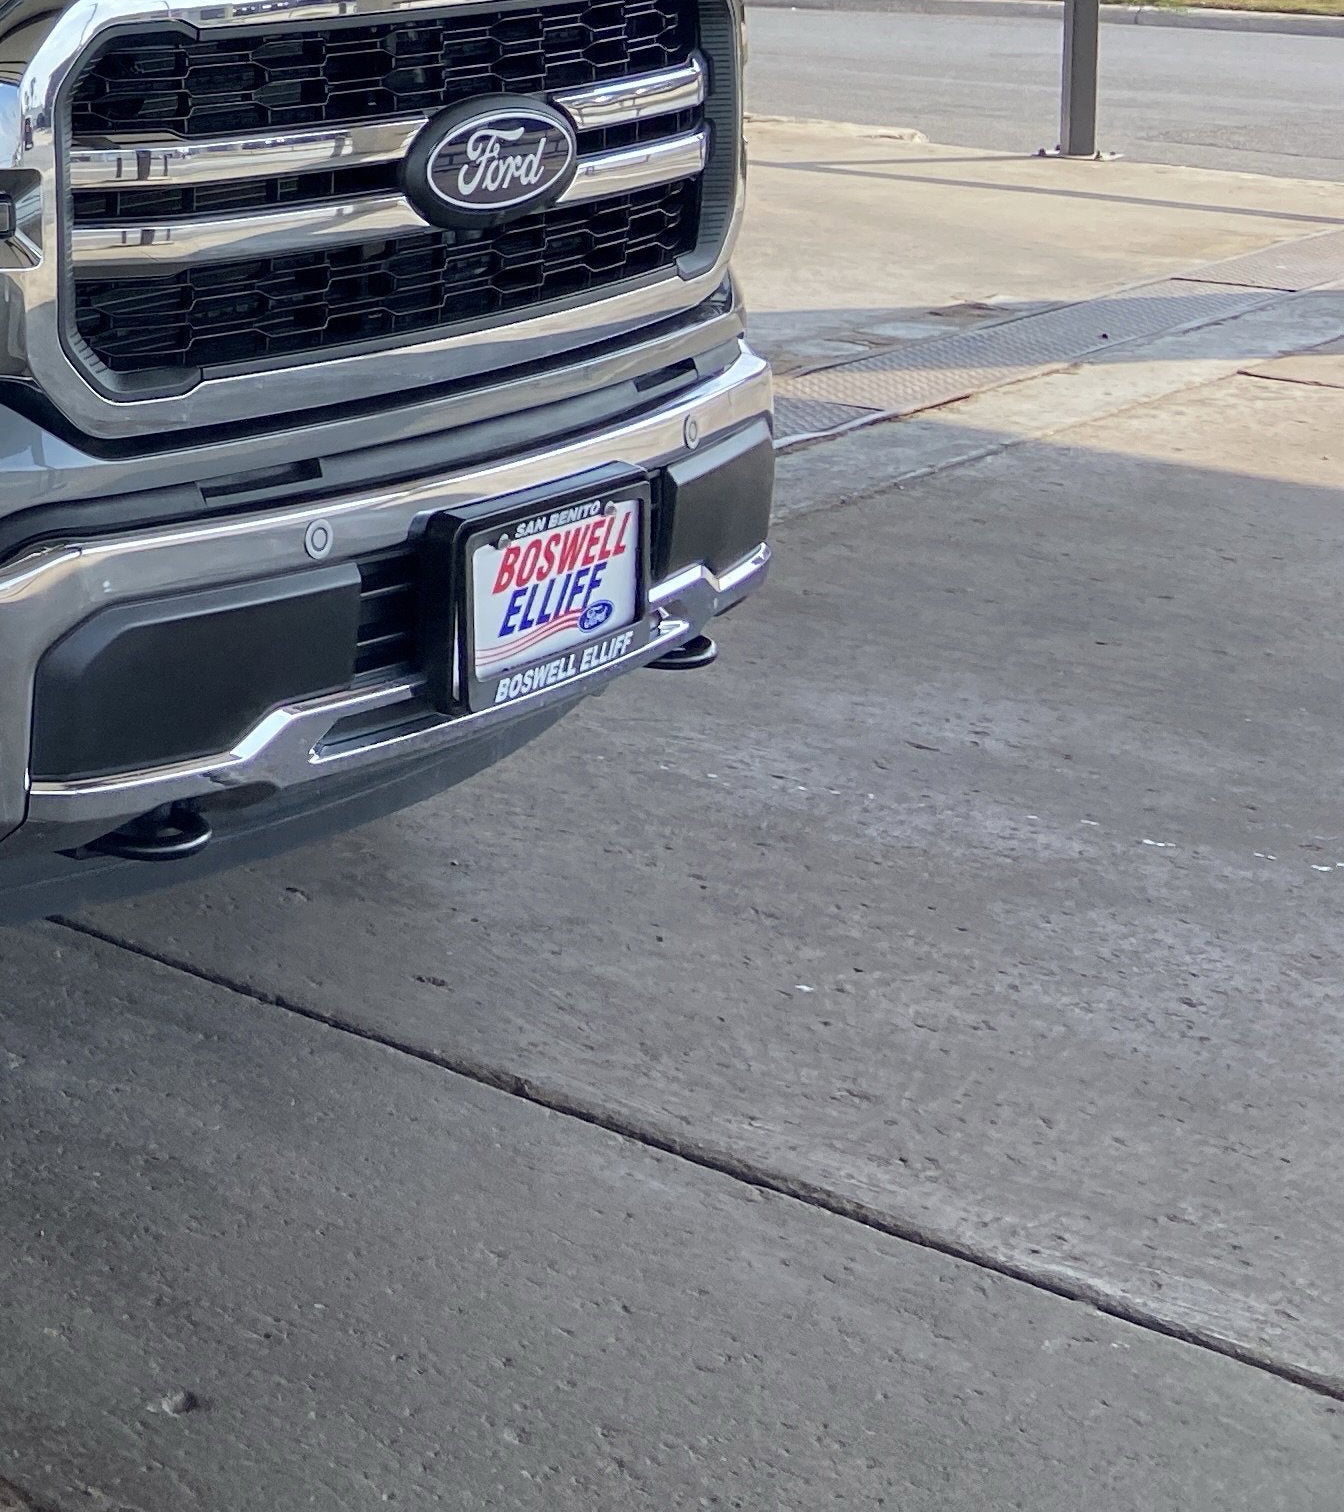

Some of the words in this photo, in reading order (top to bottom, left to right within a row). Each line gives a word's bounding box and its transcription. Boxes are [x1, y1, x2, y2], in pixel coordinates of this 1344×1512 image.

[457, 126, 547, 196] Ford
[493, 511, 632, 594] BOSWELL
[515, 516, 547, 538] SAN
[547, 499, 601, 529] BENITO
[498, 561, 607, 637] ELLIFF
[581, 603, 610, 630] Ford
[495, 654, 577, 703] BOSWELL
[579, 631, 634, 672] ELLIFF
